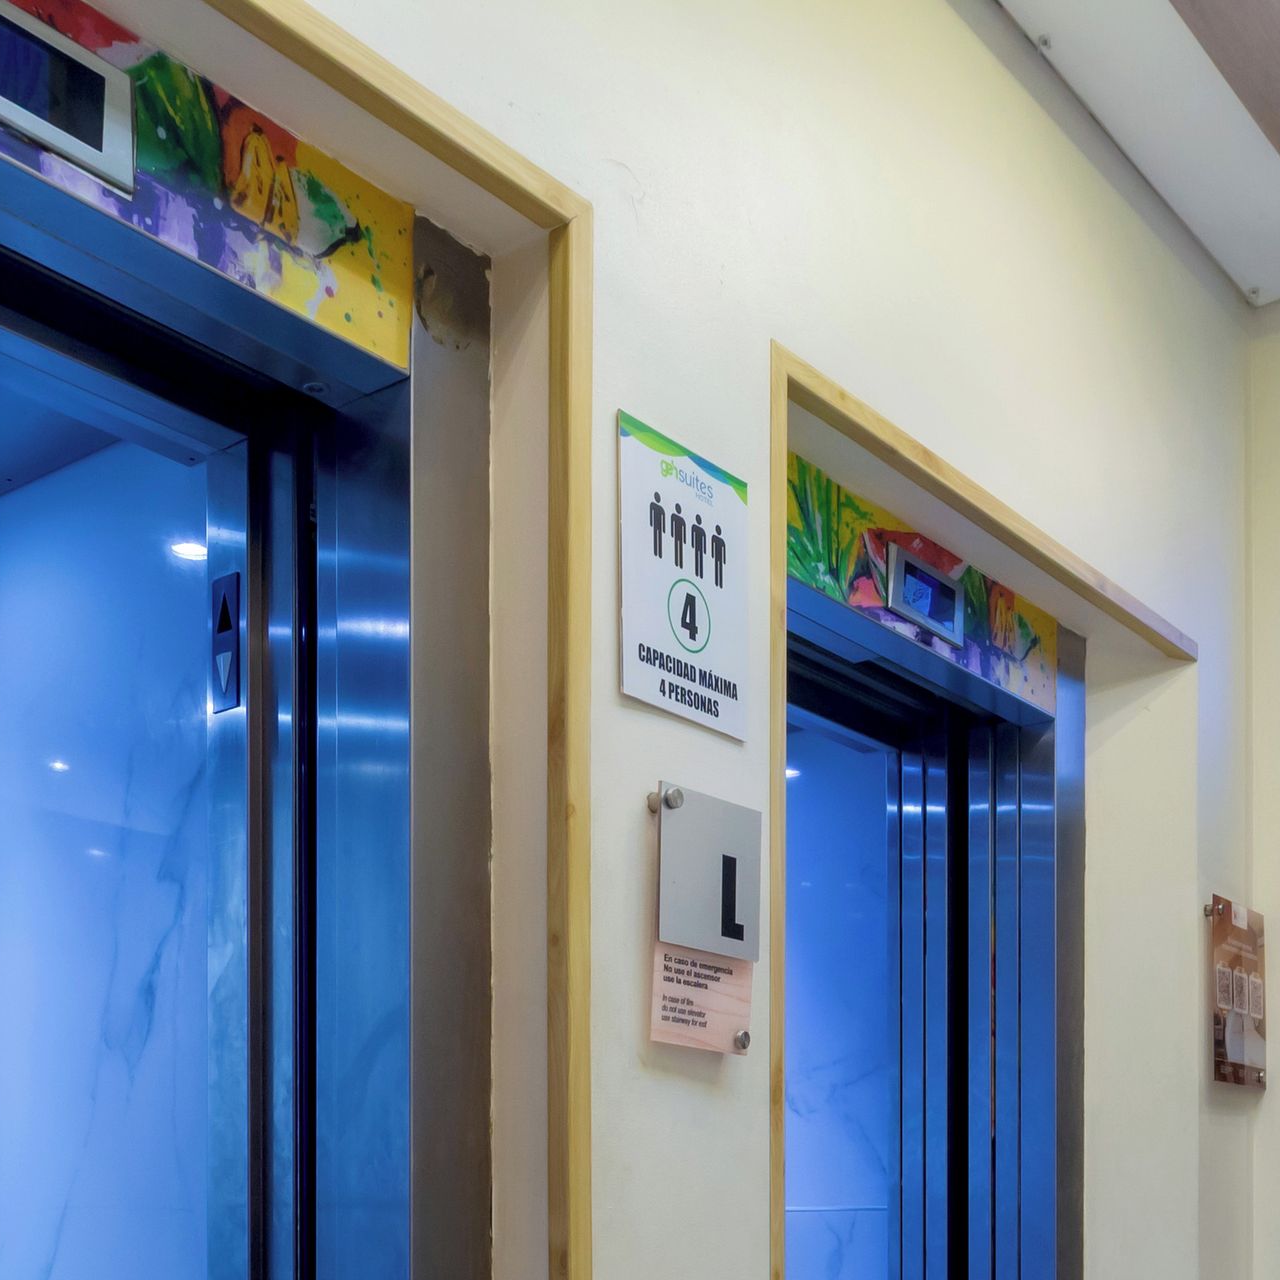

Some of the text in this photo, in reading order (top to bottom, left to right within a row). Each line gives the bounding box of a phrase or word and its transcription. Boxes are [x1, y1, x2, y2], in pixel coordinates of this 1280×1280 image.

[681, 592, 698, 641] 4
[638, 642, 738, 701] CAPACIDAD MÁXIMA
[659, 678, 719, 718] 4 PERSONAS
[721, 854, 745, 941] L
[663, 964, 721, 983] No use el ascensor
[663, 975, 708, 990] use la escalera
[664, 953, 733, 976] En caso de emergencia
